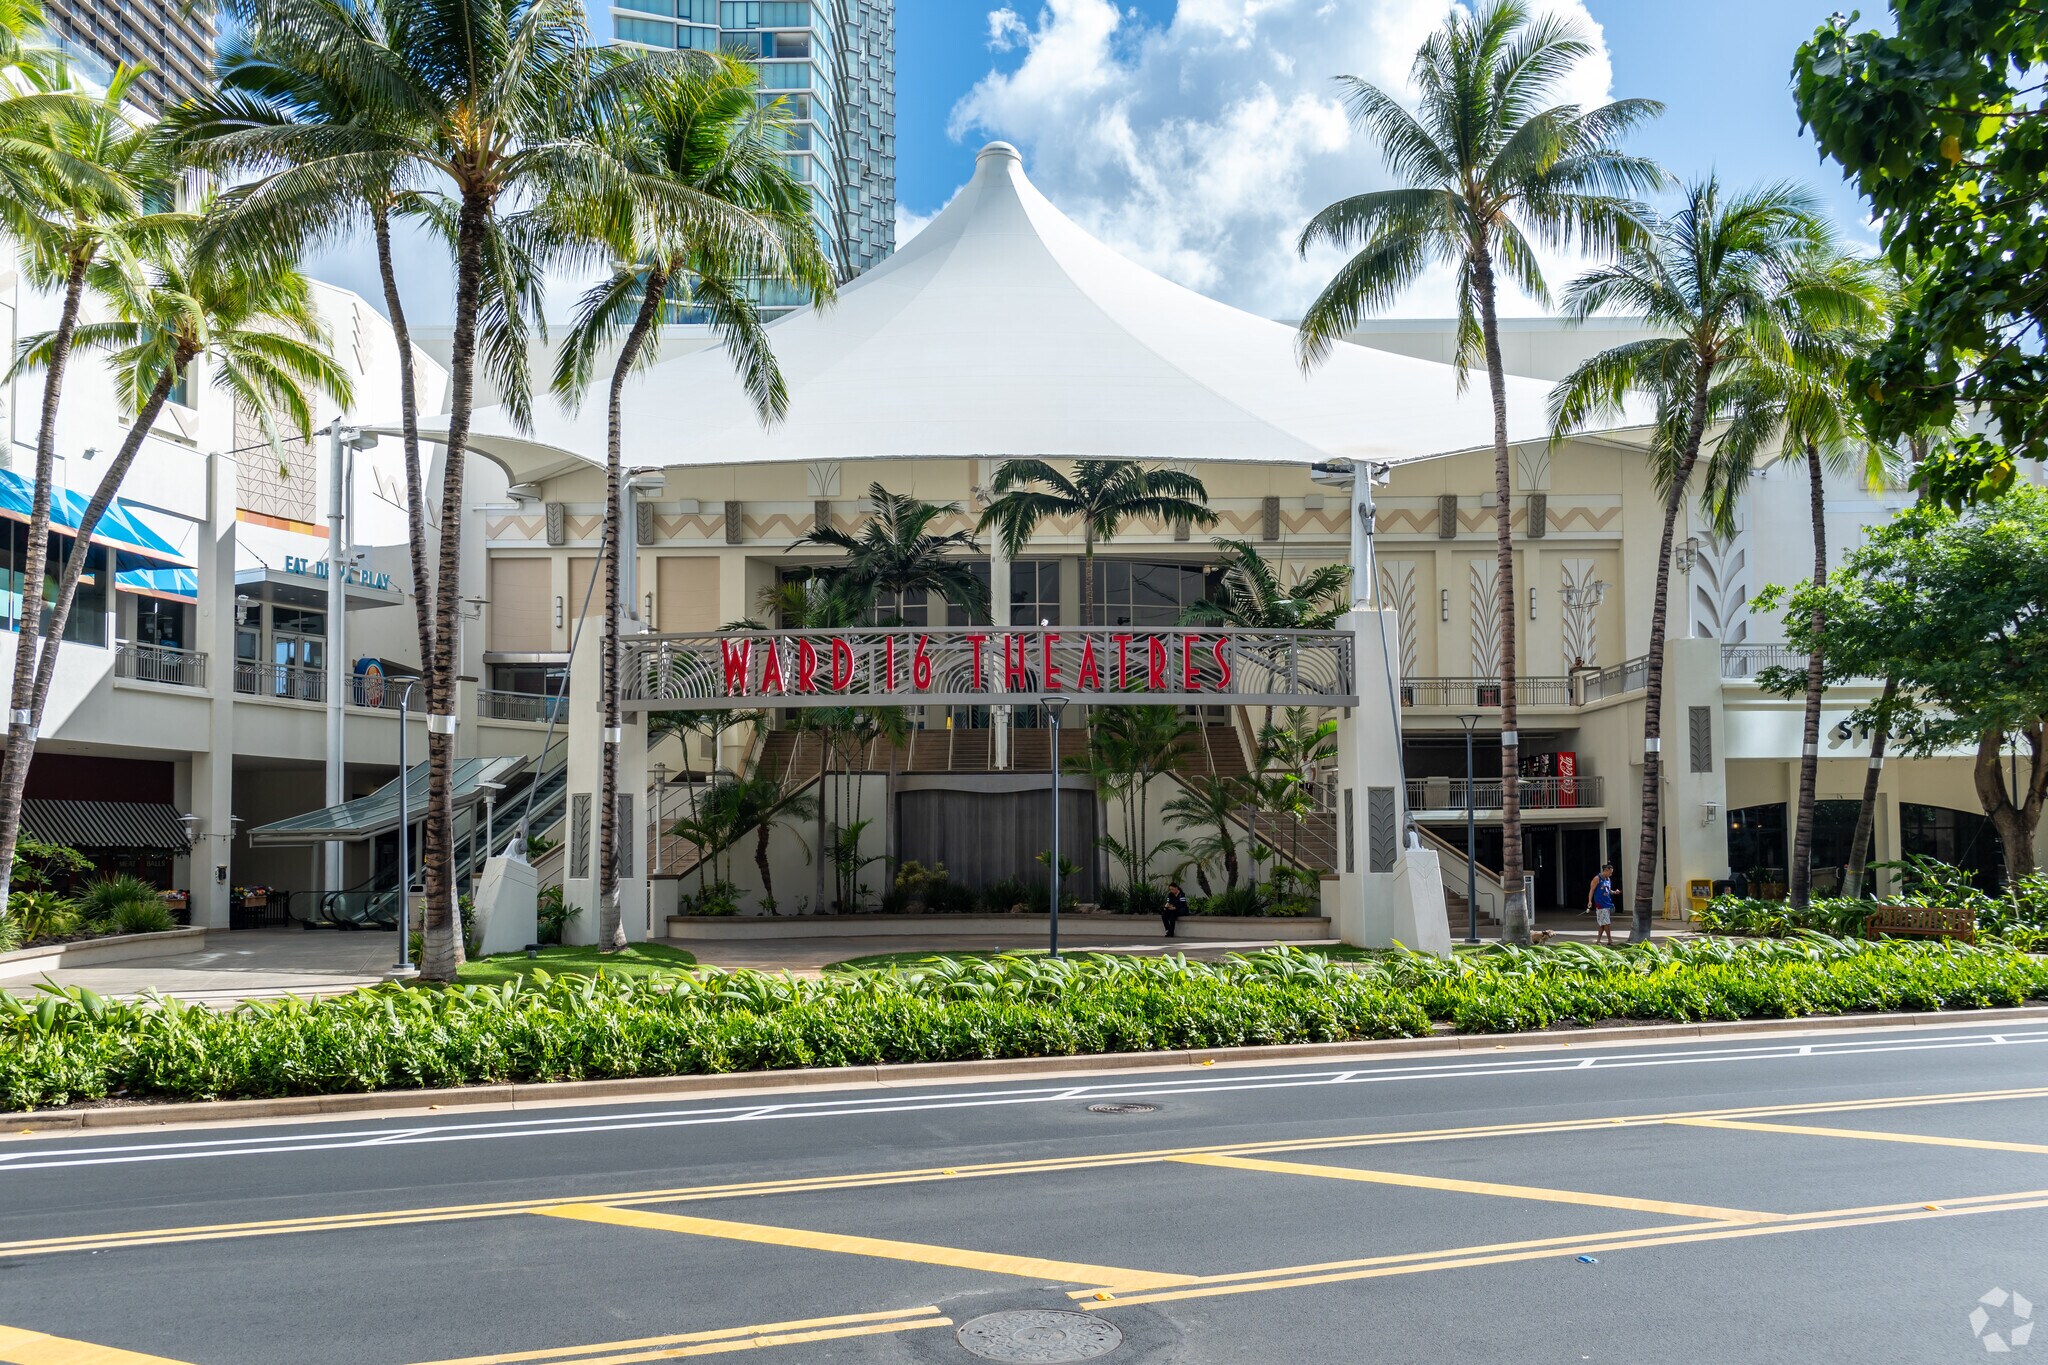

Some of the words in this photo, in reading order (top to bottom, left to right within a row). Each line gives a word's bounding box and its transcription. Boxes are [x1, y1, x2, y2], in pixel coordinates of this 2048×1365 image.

[285, 555, 308, 576] EAT
[361, 569, 390, 591] PLAY
[721, 636, 855, 698] WARD
[886, 635, 932, 692] 16
[966, 633, 1232, 690] THEATRES
